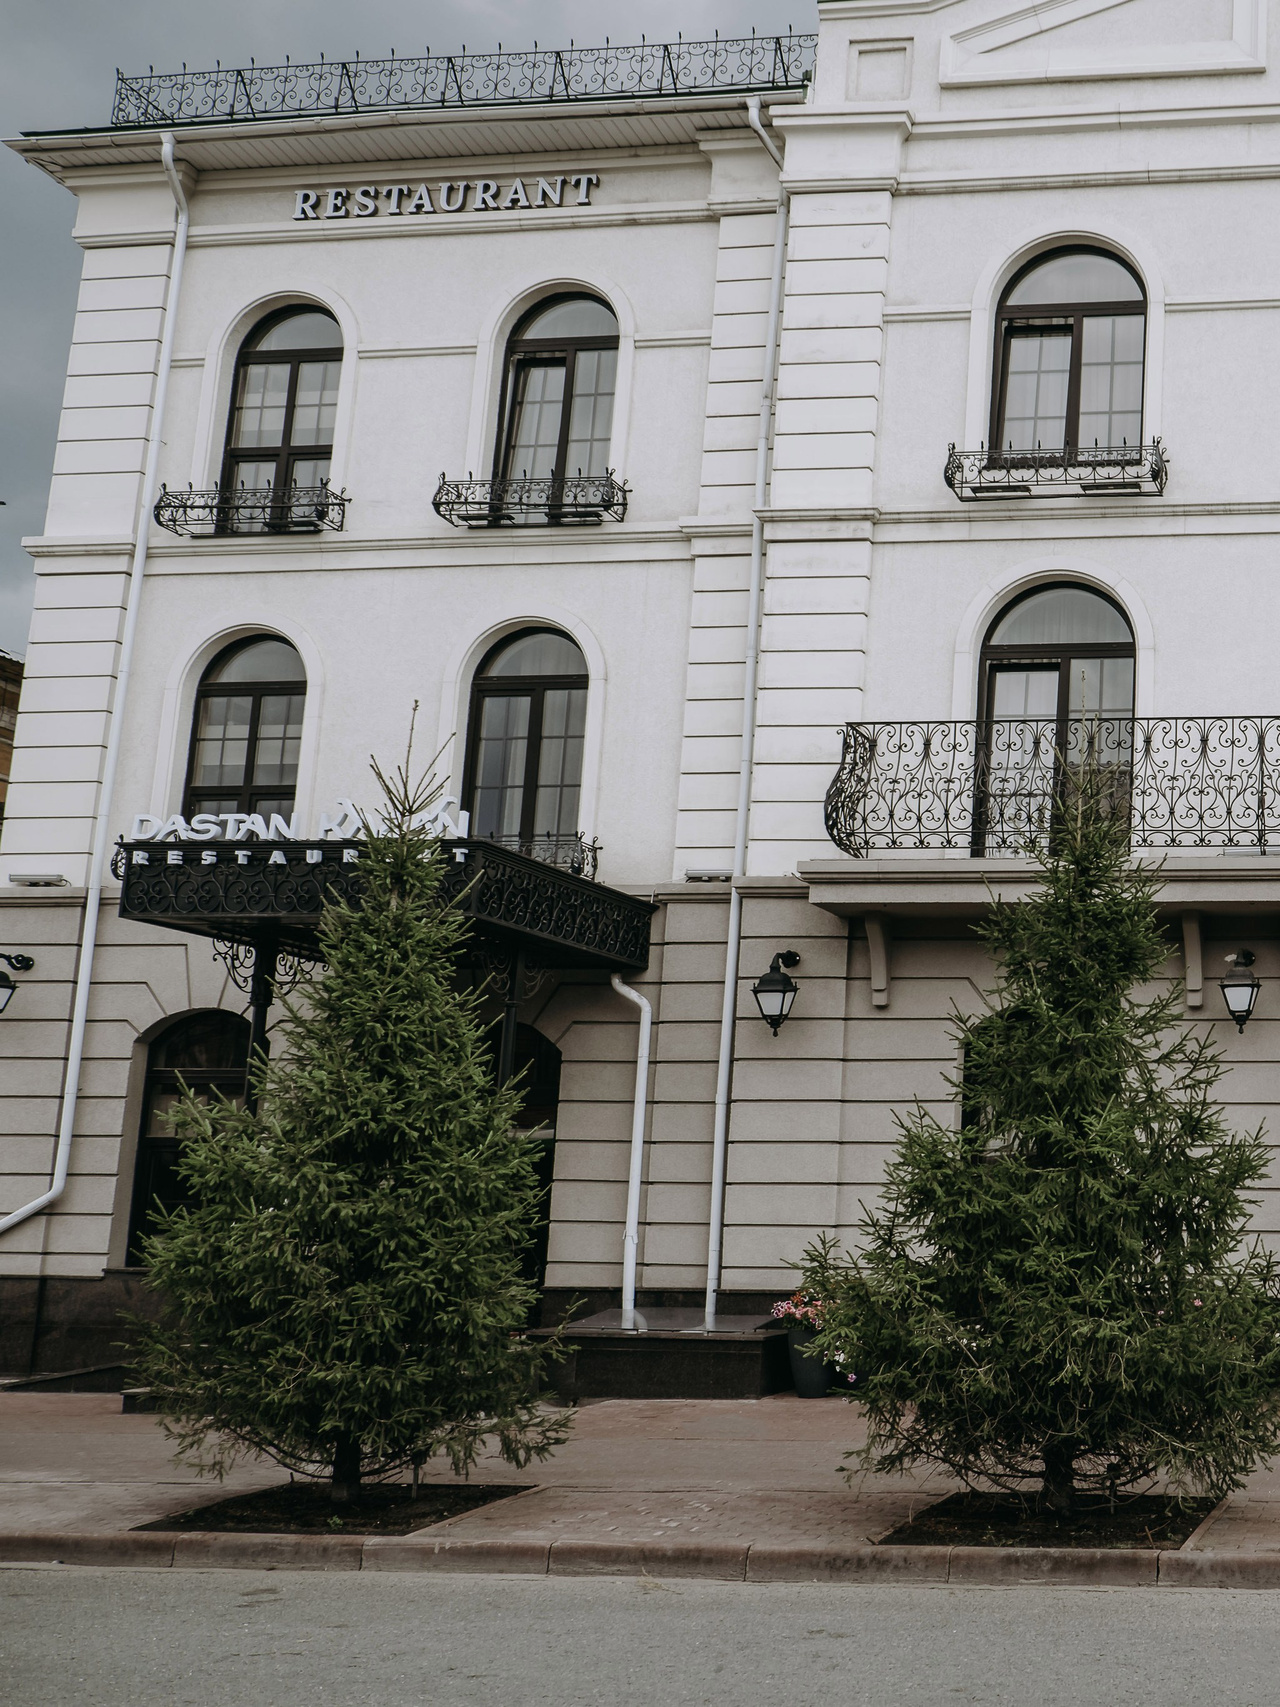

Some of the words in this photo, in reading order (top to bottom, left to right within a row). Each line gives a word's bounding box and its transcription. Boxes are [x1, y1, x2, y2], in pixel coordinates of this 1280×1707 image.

[292, 173, 599, 221] RESTAURANT
[131, 813, 300, 841] DASTAN
[132, 848, 469, 865] RESTAURT
